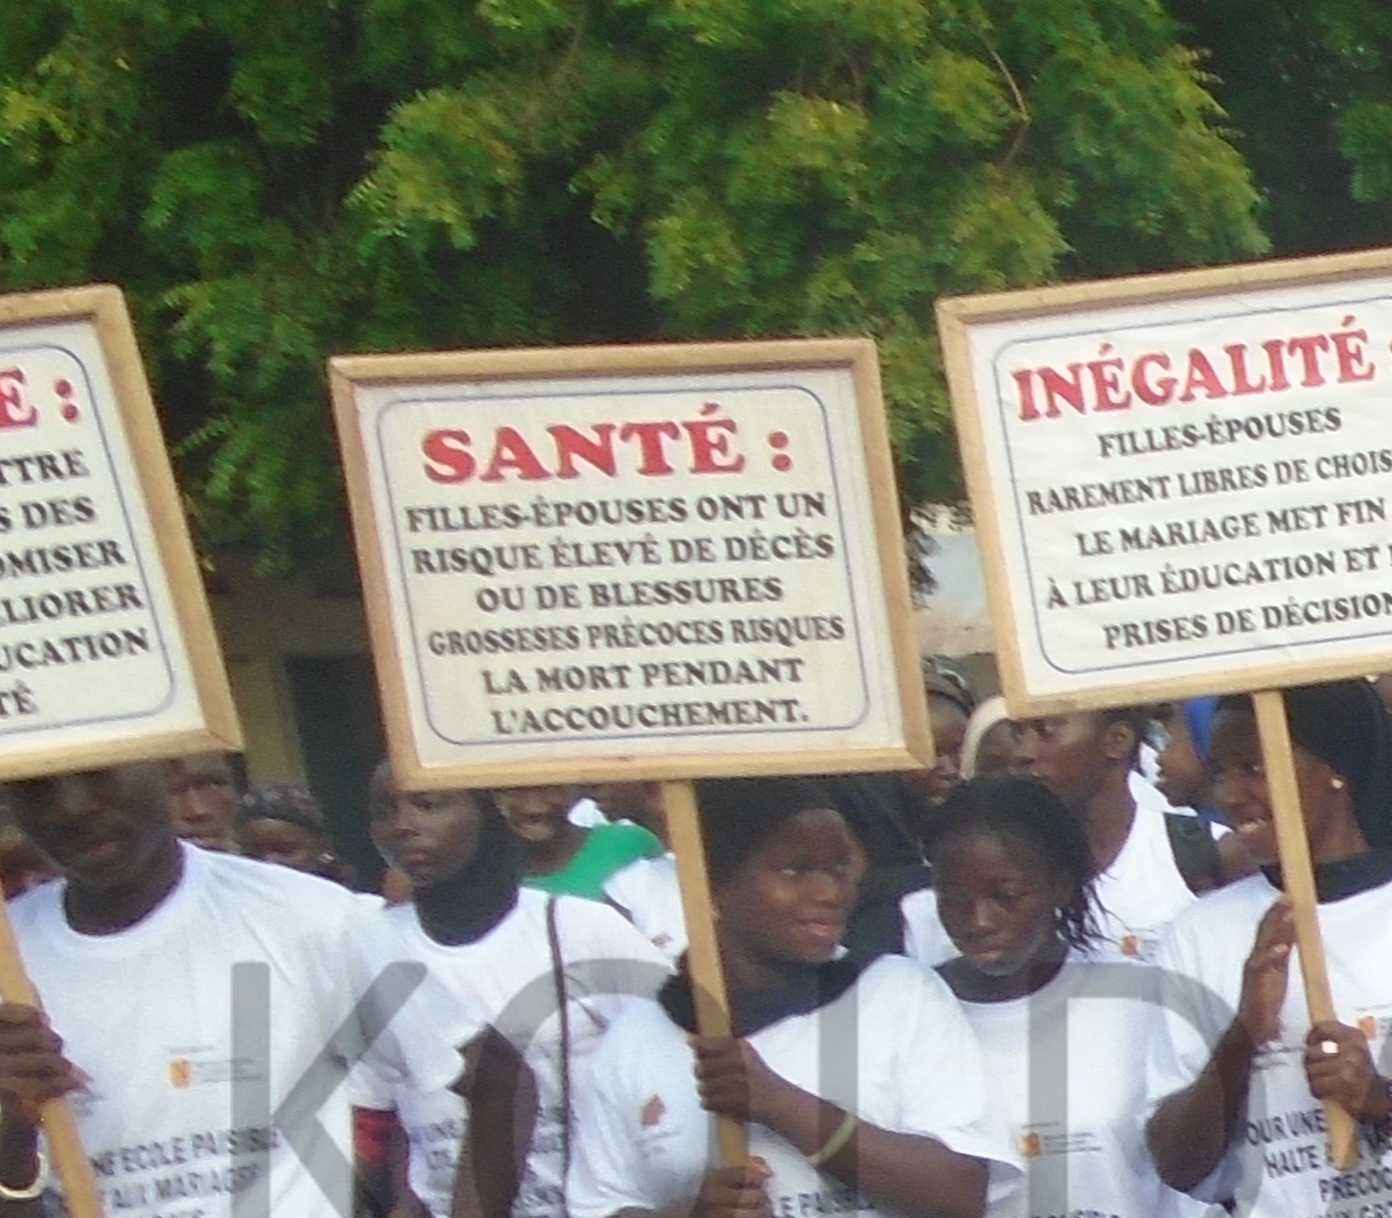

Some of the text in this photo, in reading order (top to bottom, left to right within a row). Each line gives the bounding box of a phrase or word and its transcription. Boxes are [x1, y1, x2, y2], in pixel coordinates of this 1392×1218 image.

[1011, 314, 1376, 422] INÉGALITÉ
[422, 402, 747, 484] SANTÉ
[1098, 405, 1344, 460] FILLES-ÉPOUSES
[1024, 476, 1171, 517] RAREMENT
[1178, 462, 1269, 498] LIBRES
[1275, 457, 1311, 484] DE
[20, 495, 96, 532] DES
[406, 490, 828, 533] FILLES-ÉPOUSES ONT UN
[1074, 496, 1388, 558] LE MARIAGE MET FIN
[411, 525, 836, 577] RISQUE ÉLEVÉ DE DÉCÈS
[475, 576, 783, 613] OU DE BLESSURES
[1046, 576, 1069, 610] À
[1073, 571, 1154, 606] LEUR
[1161, 548, 1337, 595] ÉDUCATION
[1343, 544, 1381, 573] ET
[587, 614, 724, 649] PRÉCOCES
[731, 615, 847, 649] RISQUES
[1101, 613, 1209, 651] PRISES
[1215, 607, 1257, 636] DE
[481, 657, 805, 697] LA MORT PENDANT
[492, 698, 811, 736] L'ACCOUCHEMENT.
